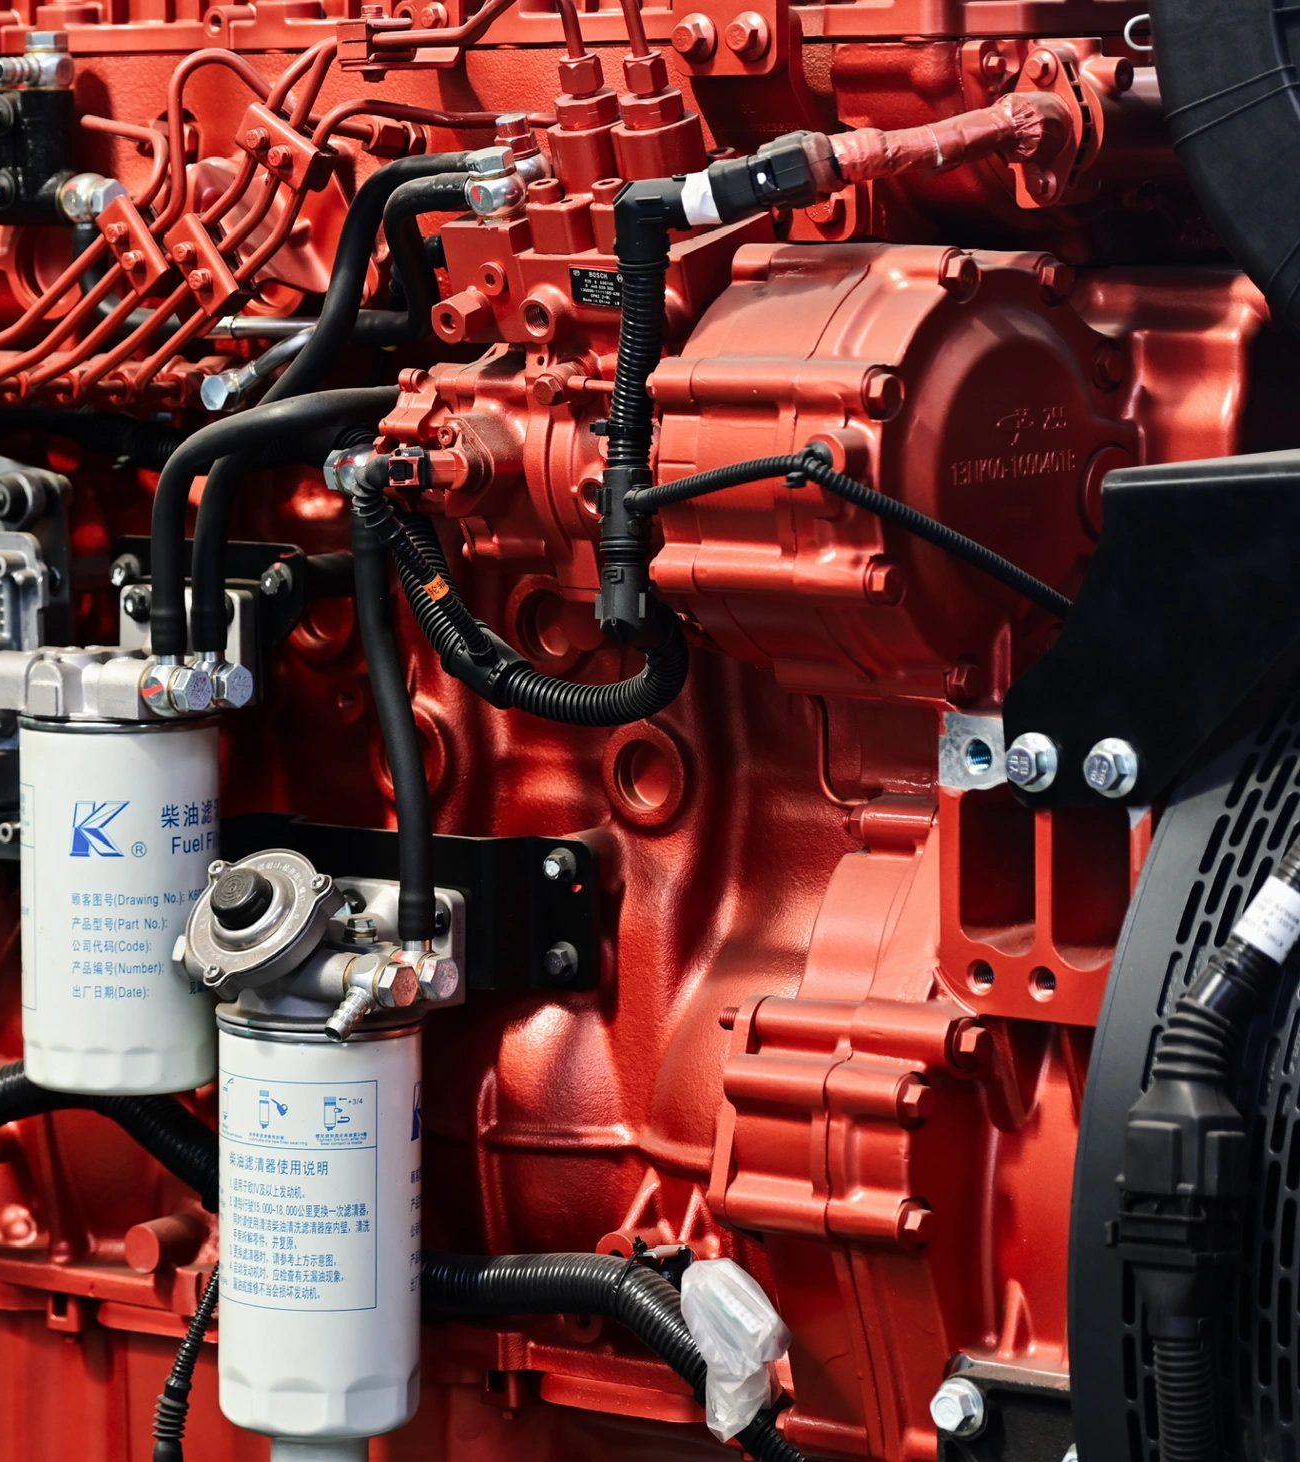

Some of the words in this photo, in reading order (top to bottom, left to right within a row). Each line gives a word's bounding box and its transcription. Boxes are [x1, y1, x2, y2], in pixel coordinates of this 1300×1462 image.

[588, 271, 608, 280] BOSCH
[172, 834, 204, 854] Fuel
[71, 917, 139, 932] 产品型号(Part
[144, 918, 168, 931] No.):
[72, 939, 152, 954] 公司代码(Code):
[72, 961, 165, 976] 产品编号(Number):
[72, 985, 149, 1000] 出厂日期(Date):
[229, 1152, 329, 1176] 柴油滤清器使用说明
